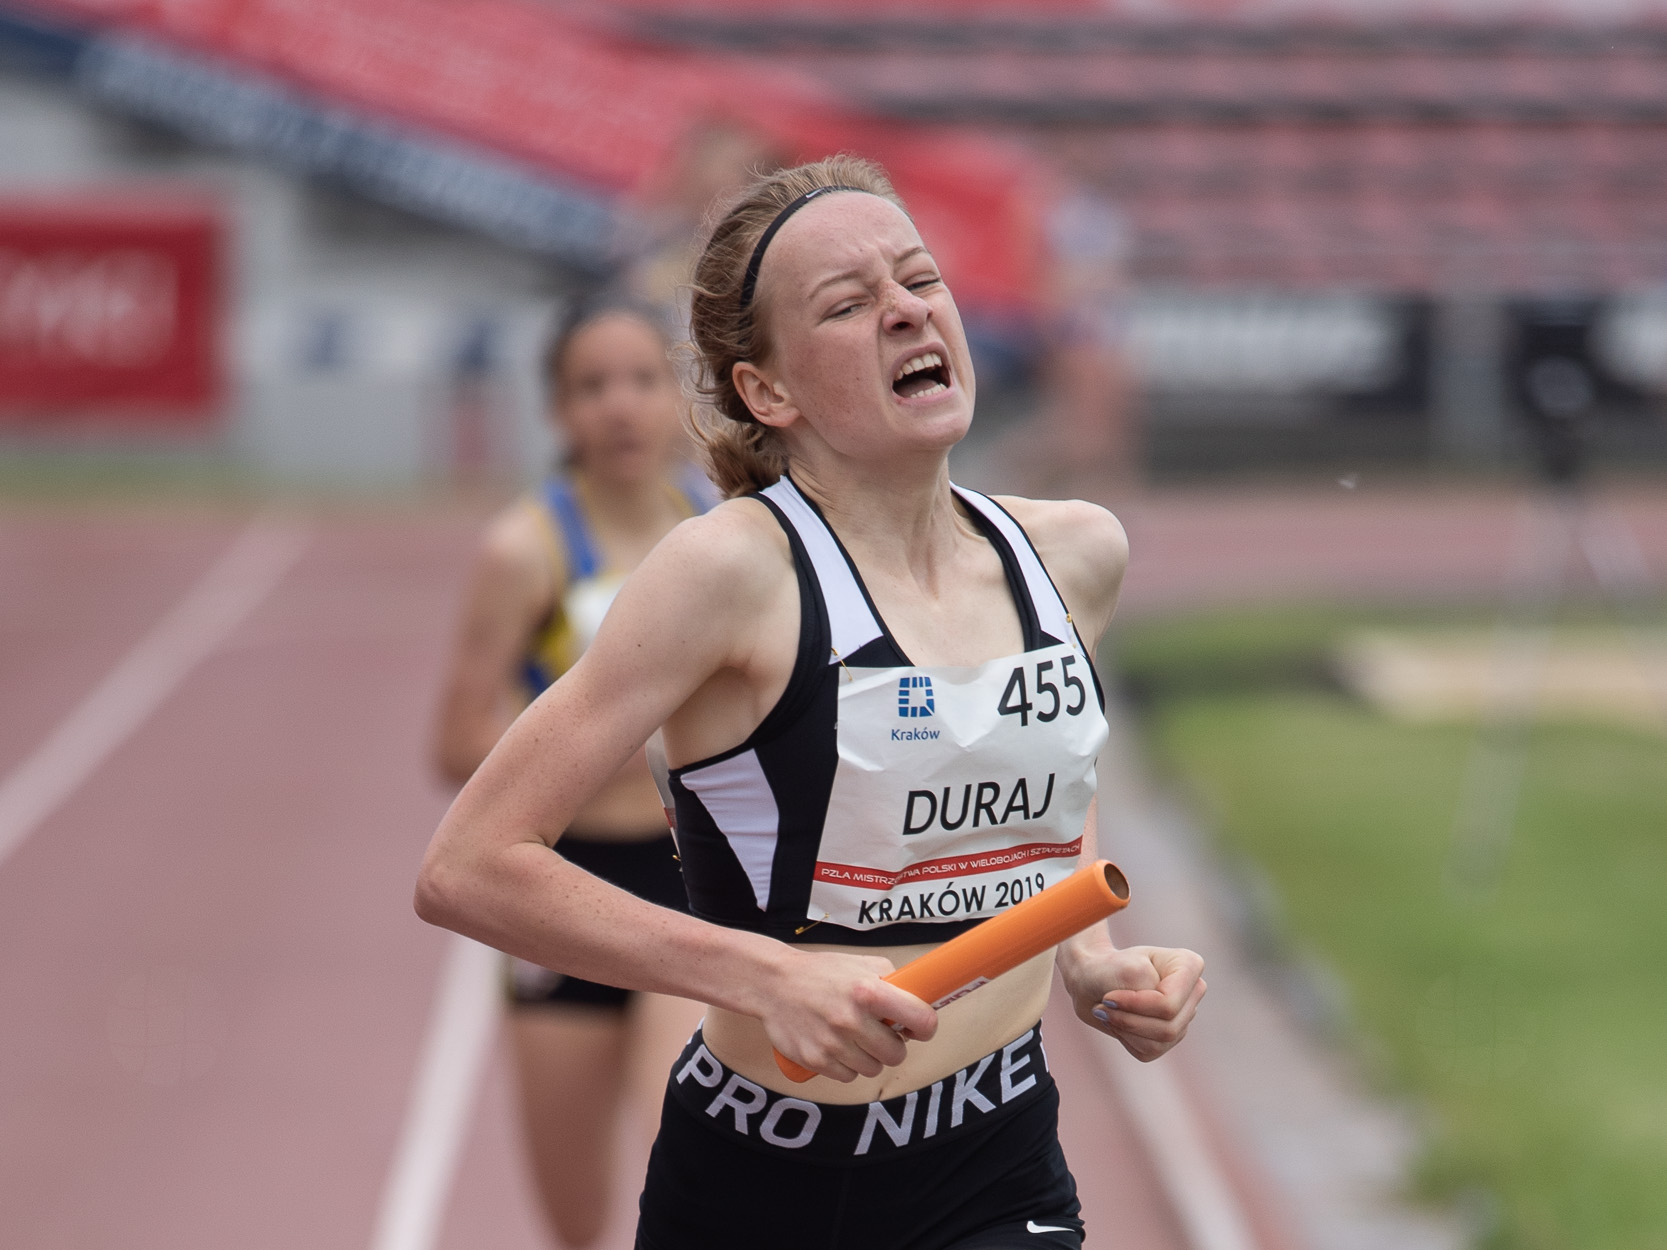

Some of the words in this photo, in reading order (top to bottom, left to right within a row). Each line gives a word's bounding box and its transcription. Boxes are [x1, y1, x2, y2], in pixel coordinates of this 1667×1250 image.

[997, 655, 1086, 727] 455
[890, 727, 941, 741] Kraków
[902, 773, 1056, 836] DURAJ
[821, 868, 851, 880] PZLA
[921, 863, 956, 874] POLSKI
[958, 861, 968, 870] W
[969, 850, 1027, 869] WIELOBOJACH
[857, 881, 987, 924] KRAKÓW
[994, 873, 1046, 909] 2019
[676, 1043, 822, 1149] PRO
[853, 1029, 1037, 1156] NIKE
